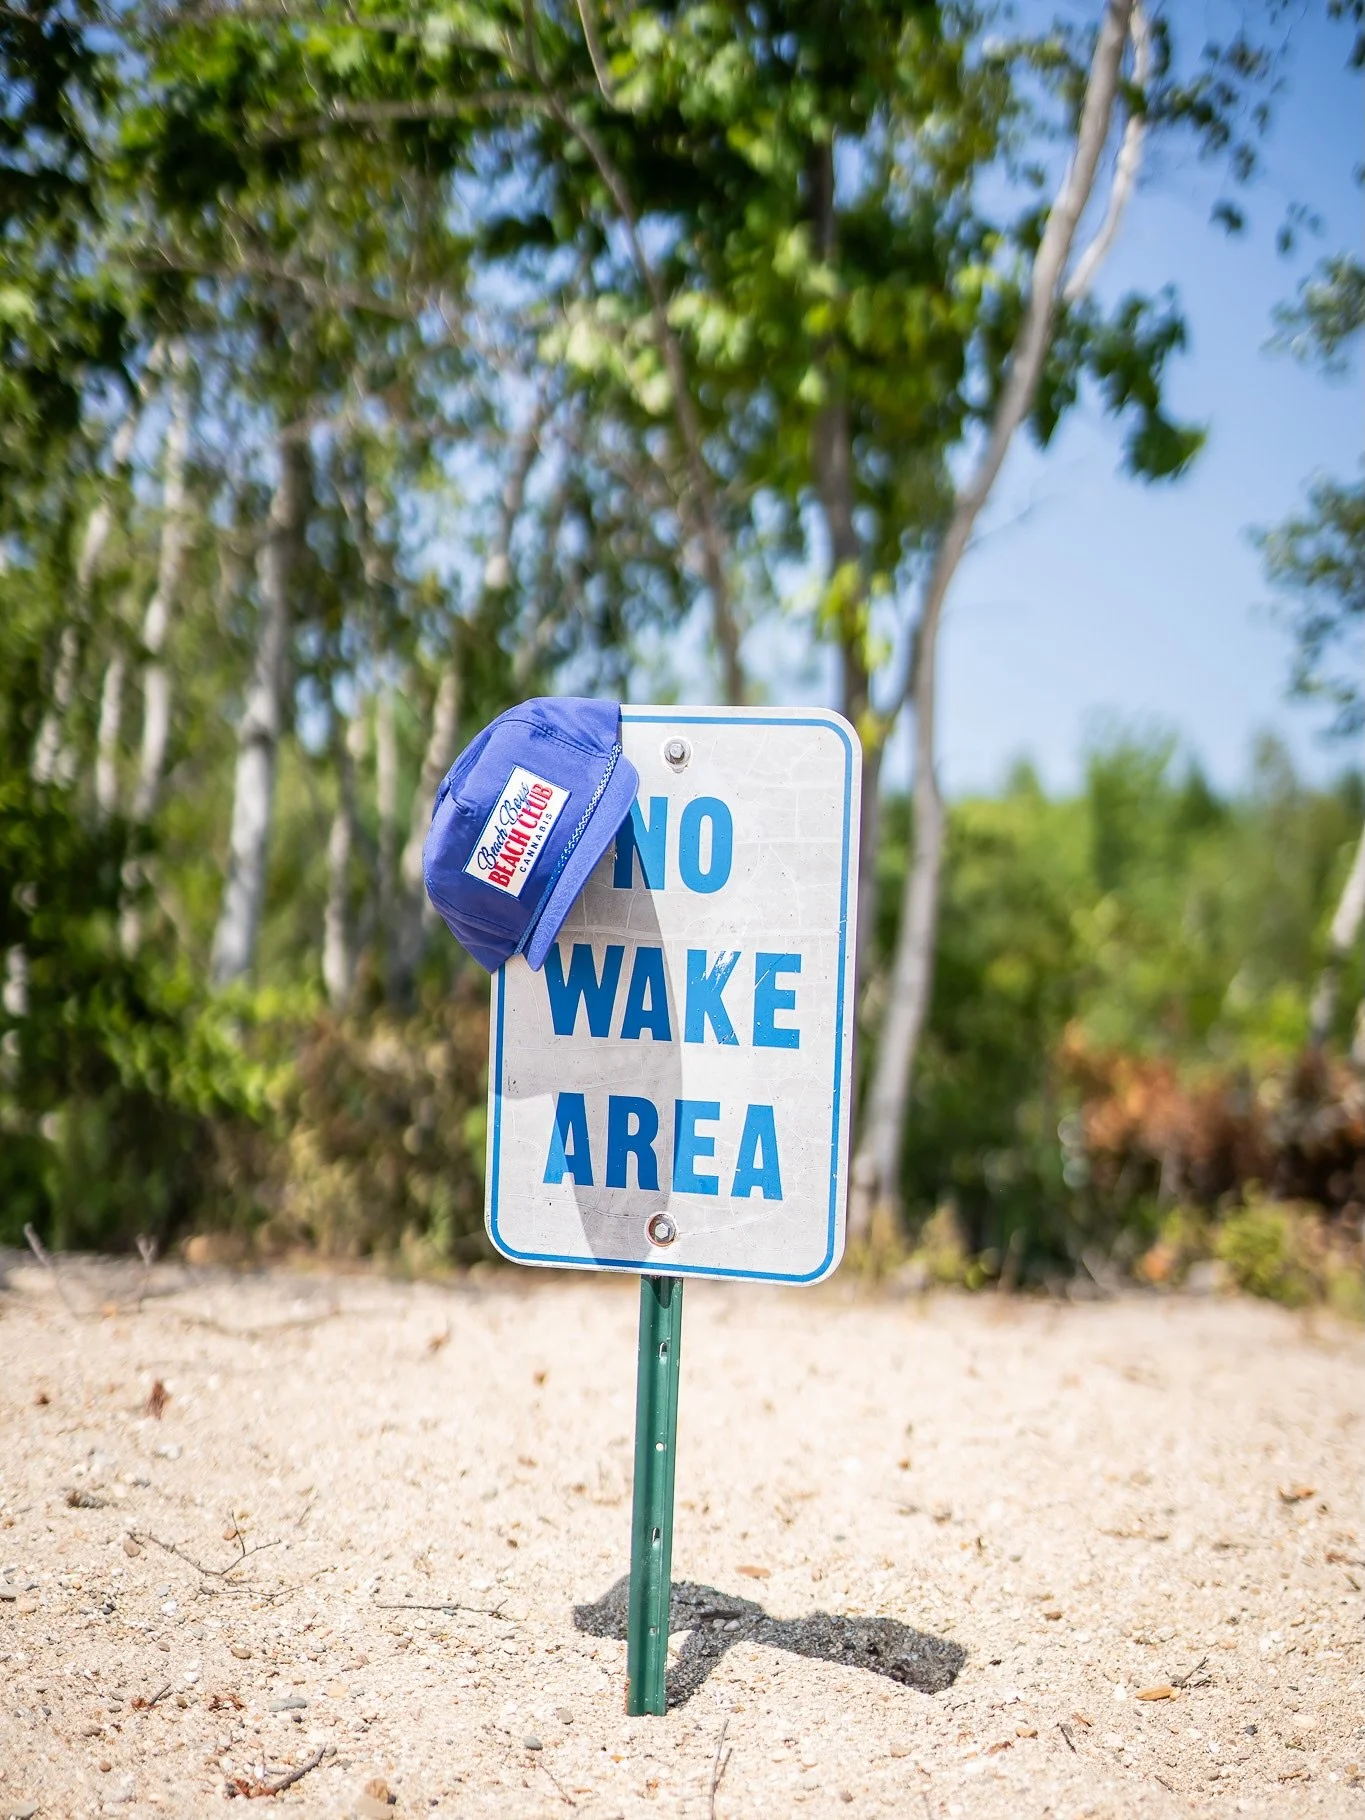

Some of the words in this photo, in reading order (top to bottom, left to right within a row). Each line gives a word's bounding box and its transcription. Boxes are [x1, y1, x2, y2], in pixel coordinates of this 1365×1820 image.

[477, 826, 509, 870] Beach
[488, 828, 531, 887] BEACH
[518, 783, 554, 829] CLUB
[519, 813, 553, 873] CANNABIS
[612, 796, 734, 894] NO
[543, 943, 802, 1049] WAKE
[543, 1092, 783, 1201] AREA
